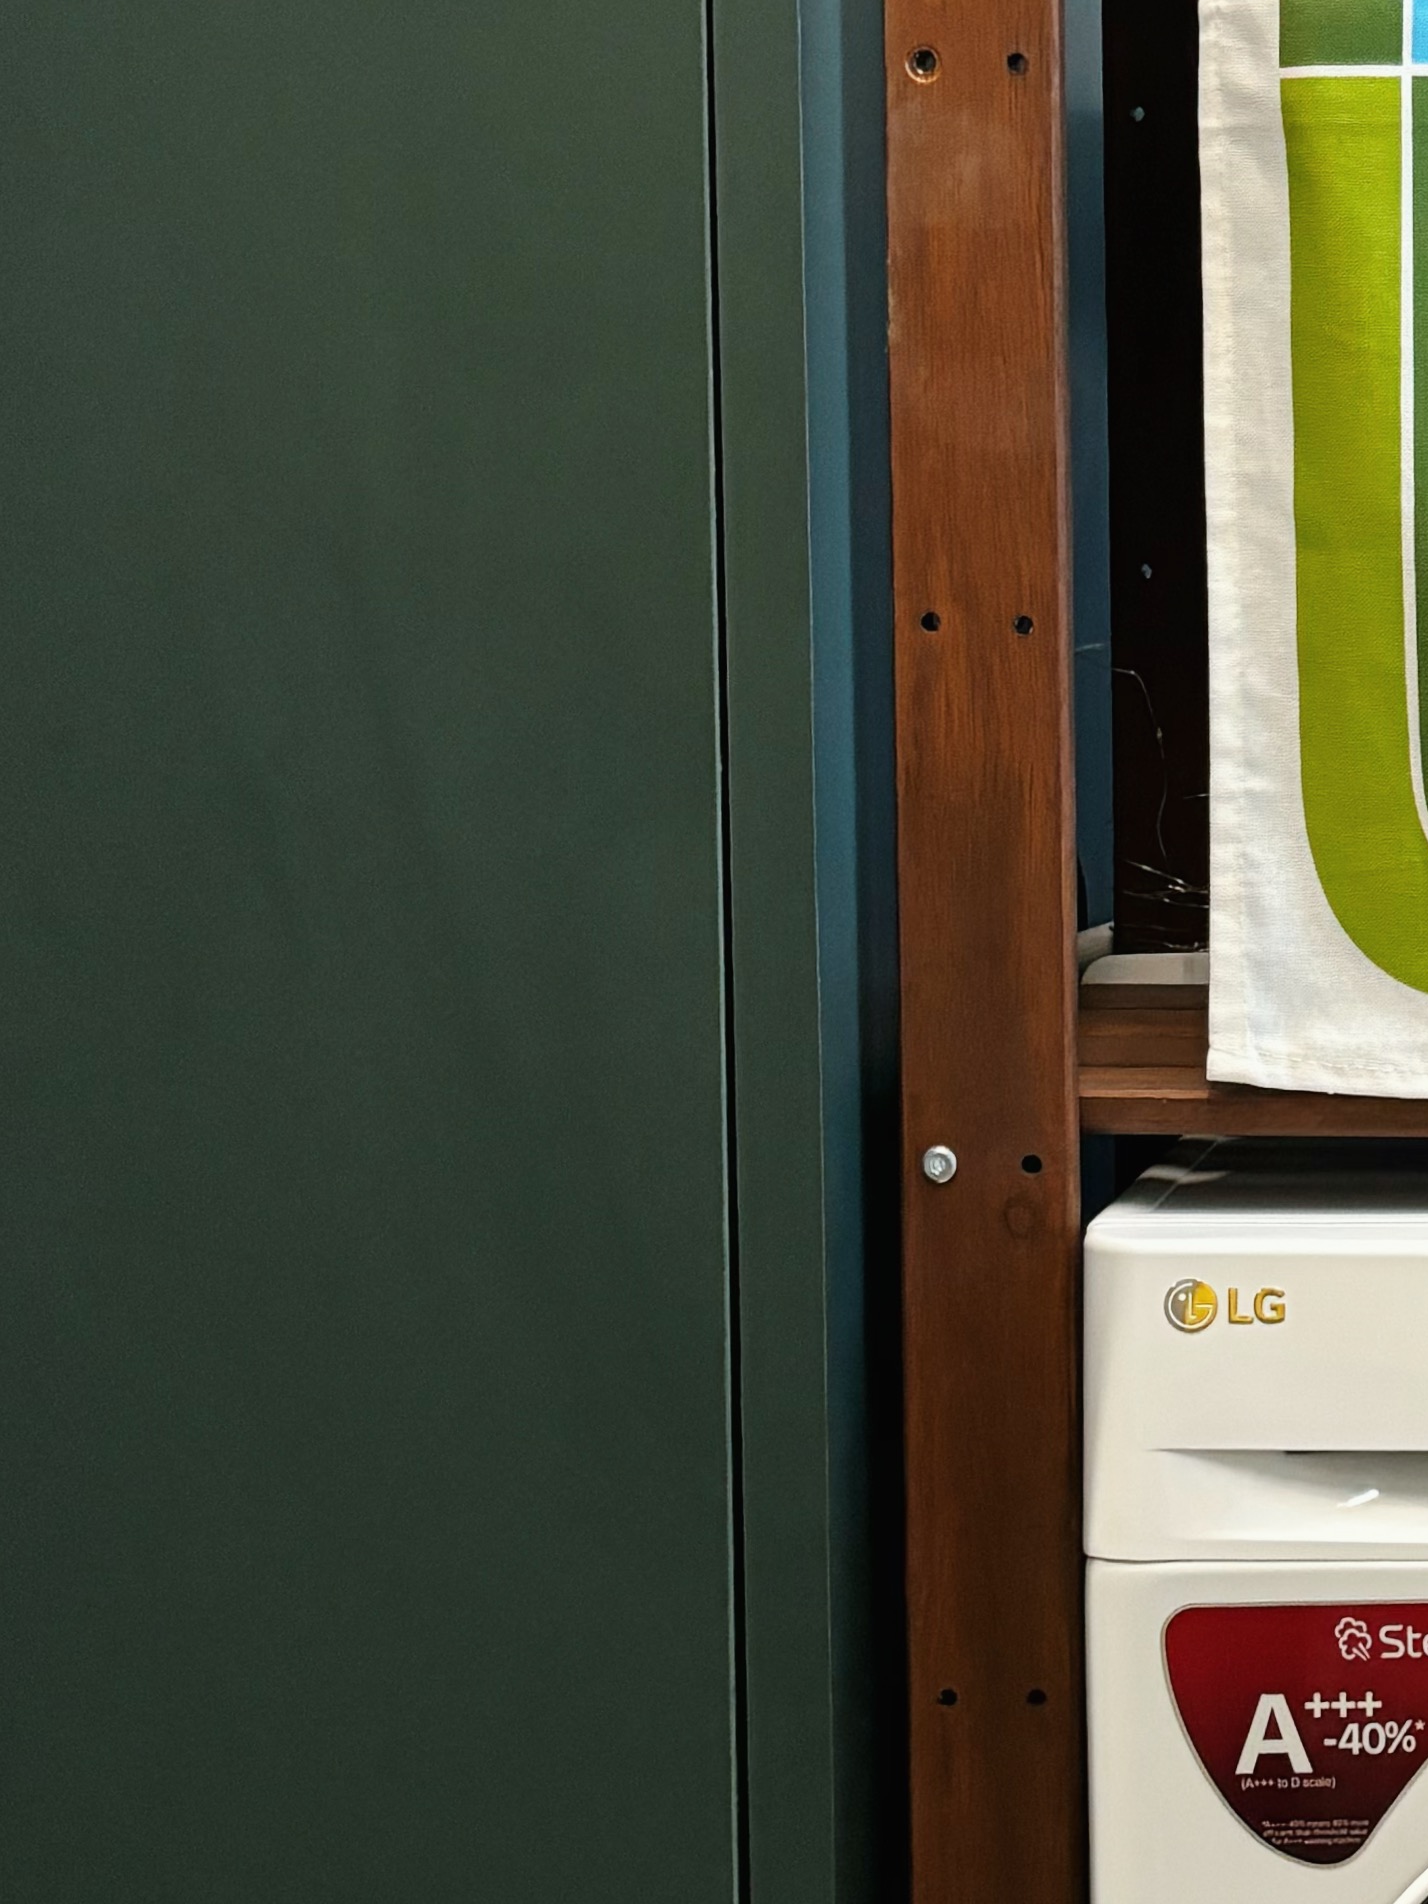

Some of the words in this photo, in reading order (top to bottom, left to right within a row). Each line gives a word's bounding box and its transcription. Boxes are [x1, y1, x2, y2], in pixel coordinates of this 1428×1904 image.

[1226, 1286, 1286, 1326] LG
[1277, 1777, 1289, 1789] to
[1290, 1777, 1301, 1789] D
